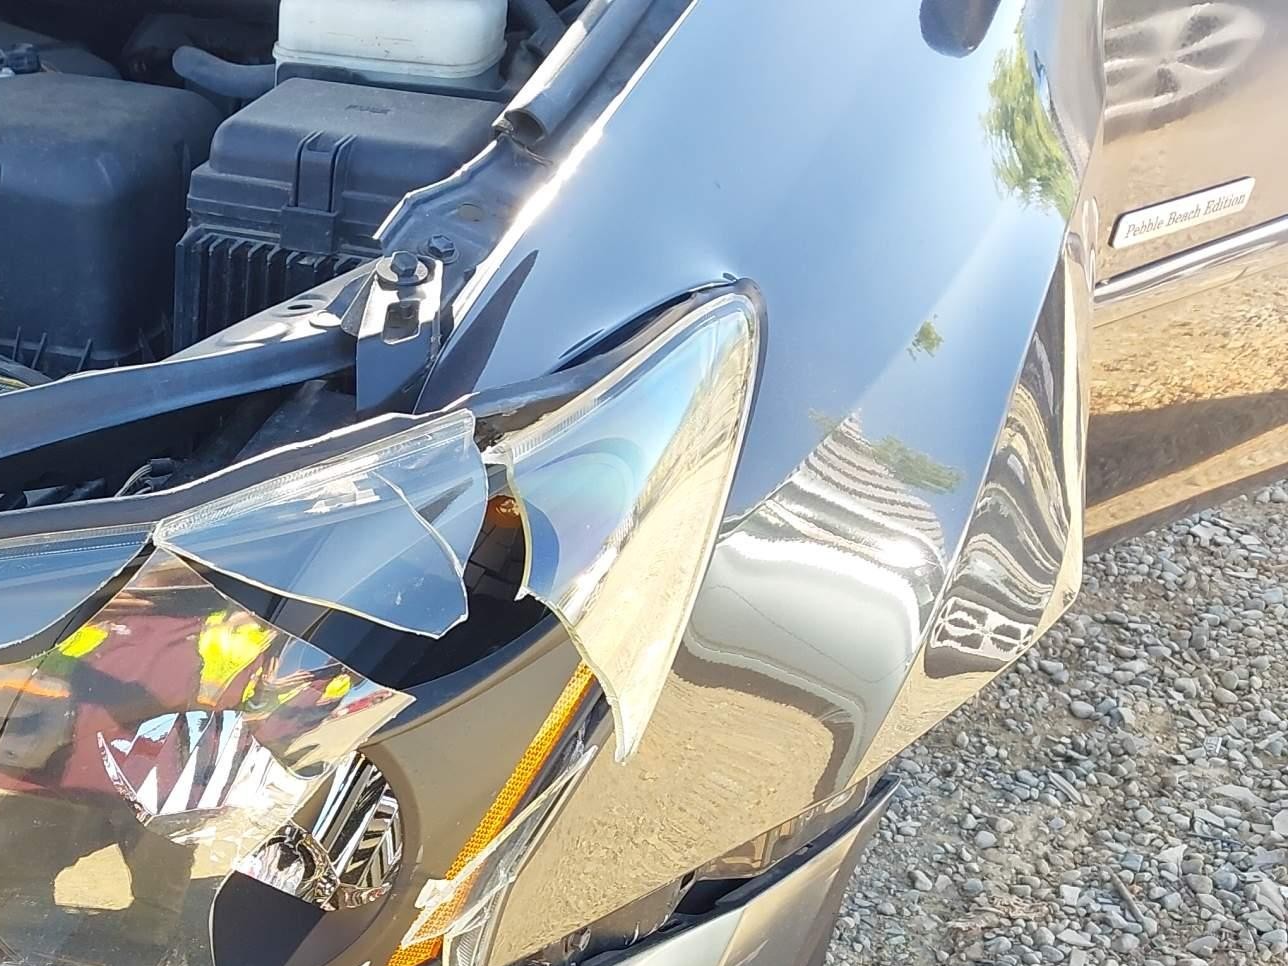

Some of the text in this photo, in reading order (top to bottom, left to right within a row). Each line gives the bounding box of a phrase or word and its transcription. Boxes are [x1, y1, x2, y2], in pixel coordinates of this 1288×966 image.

[1125, 193, 1245, 238] Pebble Beach Edition
